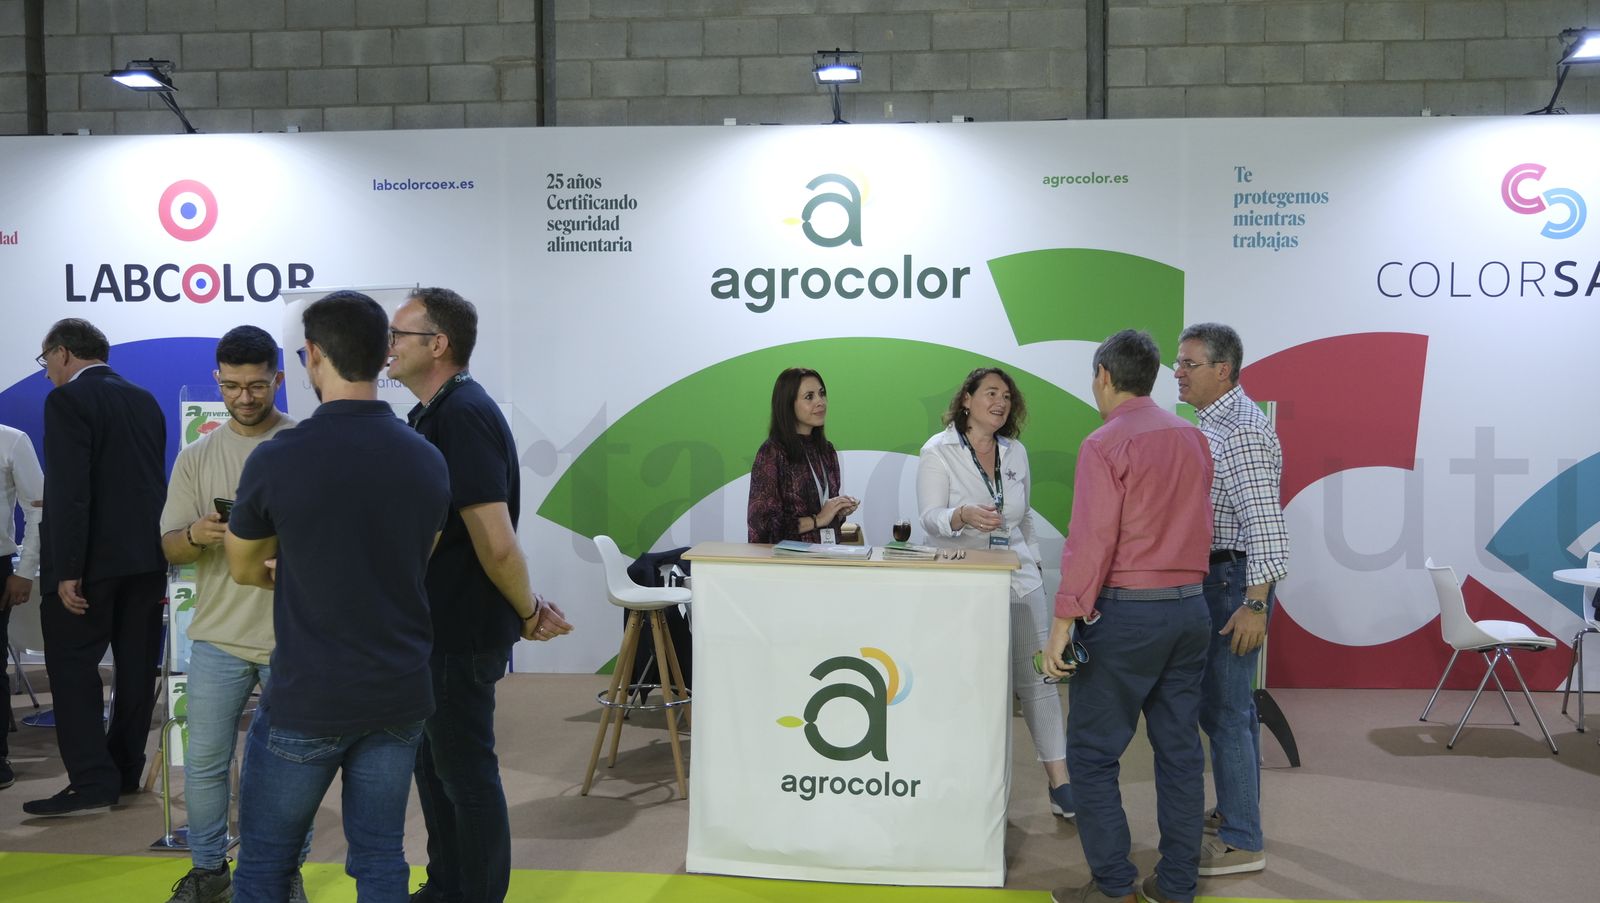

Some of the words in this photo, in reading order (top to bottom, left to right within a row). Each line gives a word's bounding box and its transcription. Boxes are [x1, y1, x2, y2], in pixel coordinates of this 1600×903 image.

[546, 172, 565, 190] 25
[566, 173, 603, 190] años
[1043, 172, 1129, 188] agrocolor.es
[1233, 165, 1253, 184] Te
[373, 178, 475, 192] labcolorcoex.es
[546, 193, 638, 211] Certificando
[1233, 190, 1330, 209] protegemos
[546, 215, 620, 236] seguridad
[1233, 209, 1306, 227] mientras
[546, 235, 633, 252] alimentaria
[1232, 231, 1300, 252] trabajas
[65, 262, 315, 304] LABCOLOR
[710, 254, 971, 314] agrocolor
[781, 771, 921, 801] agrocolor
